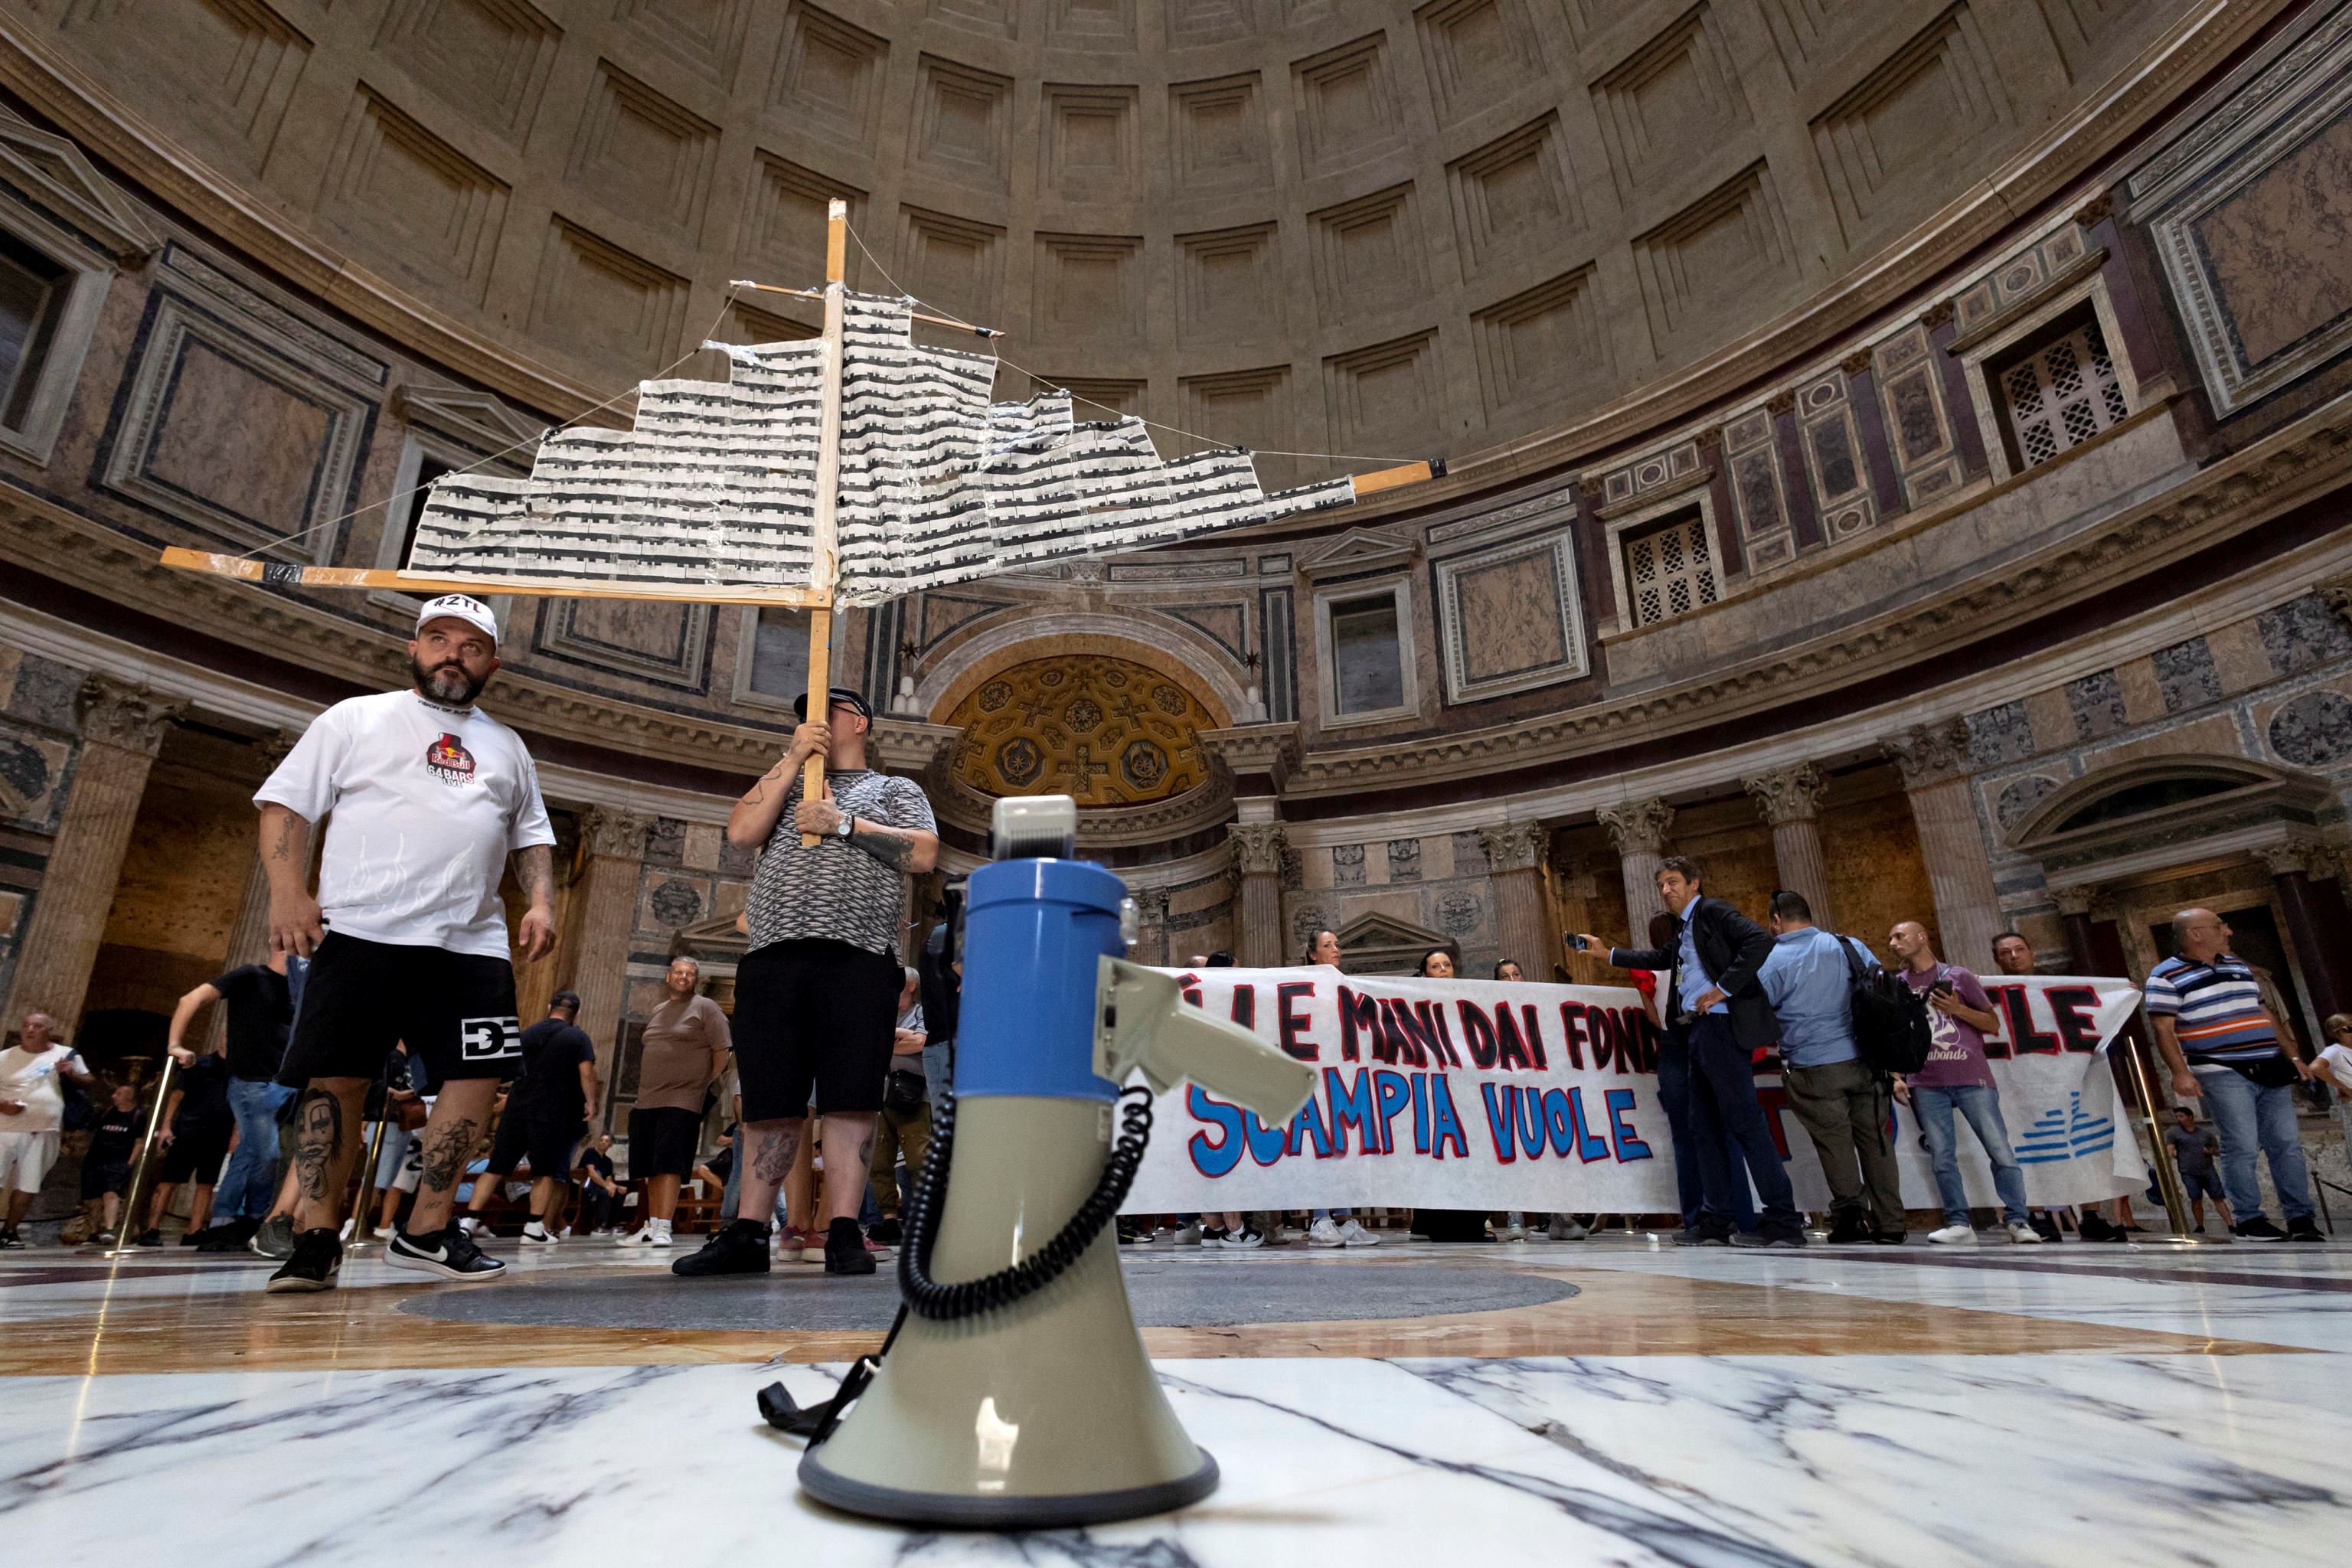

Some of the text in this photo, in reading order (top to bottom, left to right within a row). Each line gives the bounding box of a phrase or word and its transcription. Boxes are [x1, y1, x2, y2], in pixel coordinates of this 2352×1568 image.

[427, 764, 474, 784] 64 BARS
[432, 753, 470, 770] Red Bull
[1337, 985, 1461, 1070] MANI
[1456, 999, 1548, 1072] DAI
[1480, 1082, 1653, 1165] VUOLE
